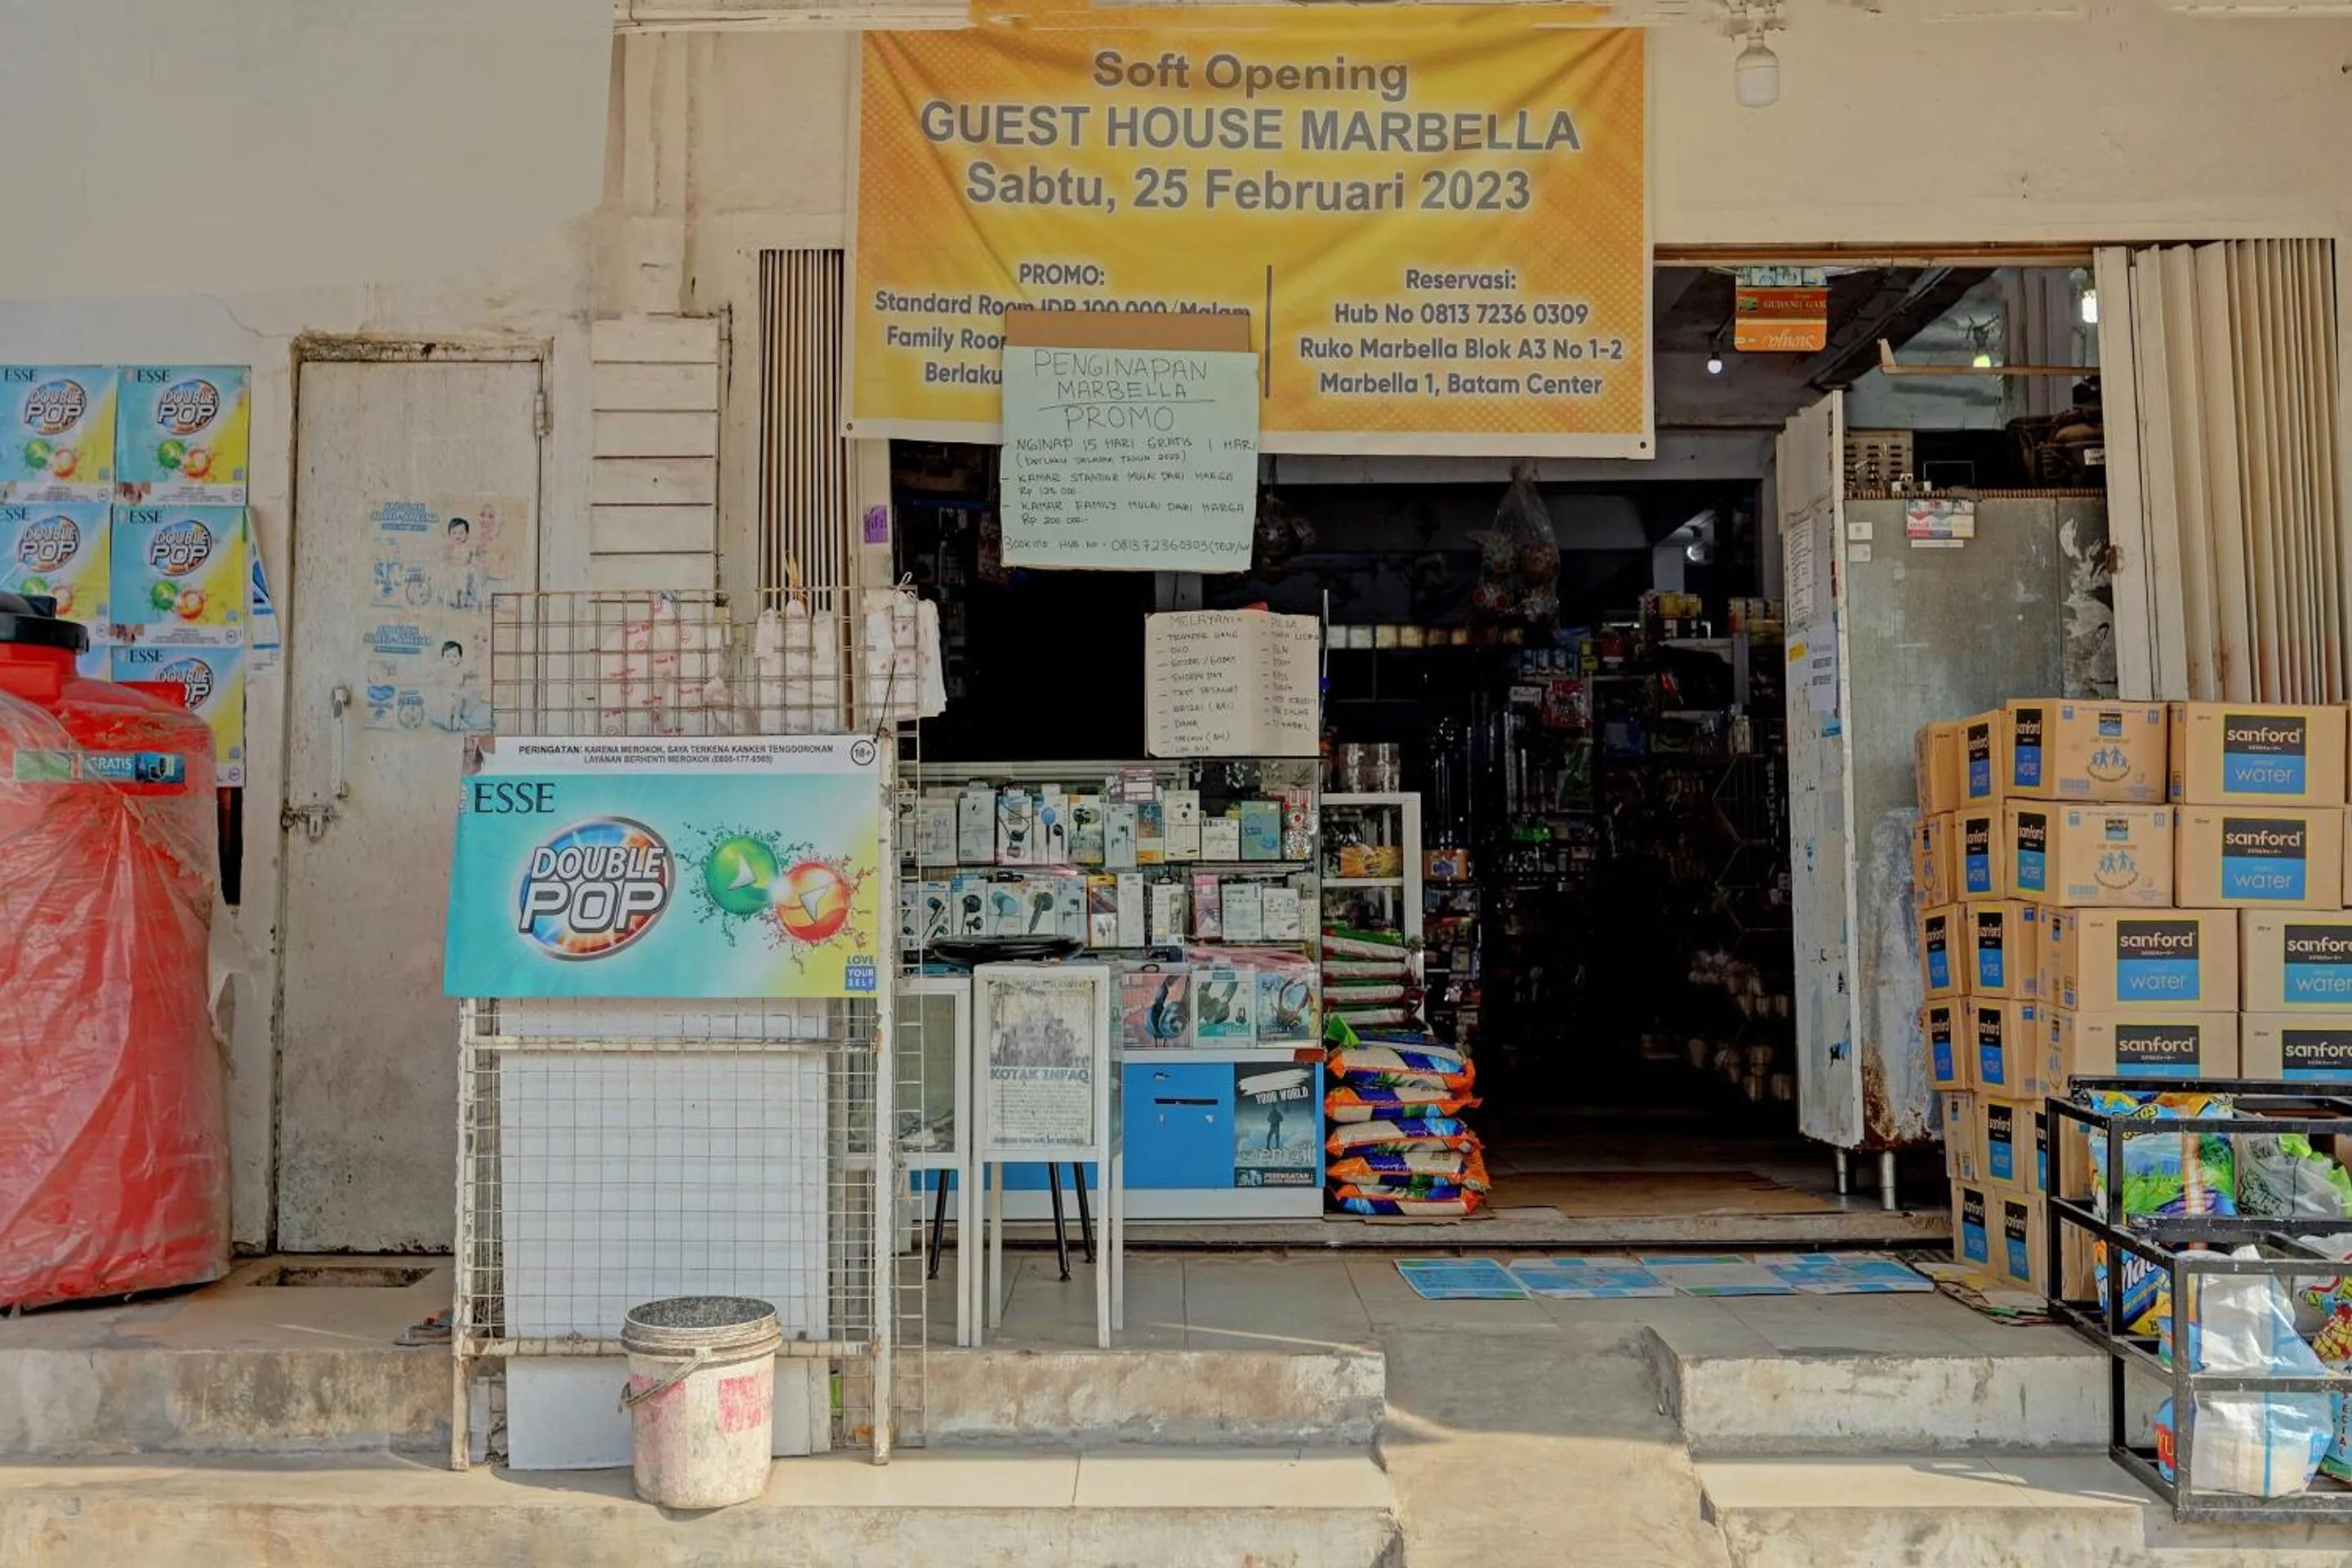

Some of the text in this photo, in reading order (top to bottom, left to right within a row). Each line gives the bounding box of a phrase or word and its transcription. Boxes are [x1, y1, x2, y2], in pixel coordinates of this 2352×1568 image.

[1094, 51, 1410, 102] Soft Opening
[920, 101, 1581, 152] GUEST HOUSE MARBELLA
[966, 161, 1531, 212] Sabtu, 25 Februari 2023
[1018, 263, 1106, 287] PROMO:
[1405, 269, 1518, 291] Reservasi:
[875, 290, 972, 315] Standard
[1334, 302, 1589, 326] Hub No 0813 7236 0309
[886, 326, 955, 353] Family
[1298, 337, 1624, 361] Ruko Marbella Blok A3 No 1-2
[4, 368, 38, 382] ESSE
[137, 368, 171, 383] ESSE
[924, 363, 1004, 386] Berlaku
[1033, 349, 1208, 381] PENGINAPAN
[1057, 380, 1187, 401] MARBELLA
[1319, 372, 1603, 398] Marbella 1, Batam Center
[163, 390, 216, 403] DOUBLE
[24, 403, 83, 424] POP
[157, 404, 216, 425] POP
[1064, 405, 1175, 432] PROMO
[129, 509, 163, 523] ESSE
[155, 531, 211, 546] DOUBLE
[19, 541, 77, 563] POP
[150, 546, 210, 565] POP
[129, 649, 163, 663] ESSE
[2227, 727, 2301, 744] sanford
[2235, 767, 2296, 784] water
[474, 782, 556, 814] ESSE
[2225, 830, 2301, 848] sanford
[531, 844, 666, 882] DOUBLE
[2234, 873, 2294, 890] water
[518, 879, 671, 934] POP
[2119, 931, 2194, 948] sanford
[847, 954, 876, 964] LOVE
[848, 968, 875, 978] YOUR
[2129, 974, 2187, 991] water
[2119, 1036, 2194, 1054] sanford
[990, 1068, 1089, 1083] KOTAK INFAQ
